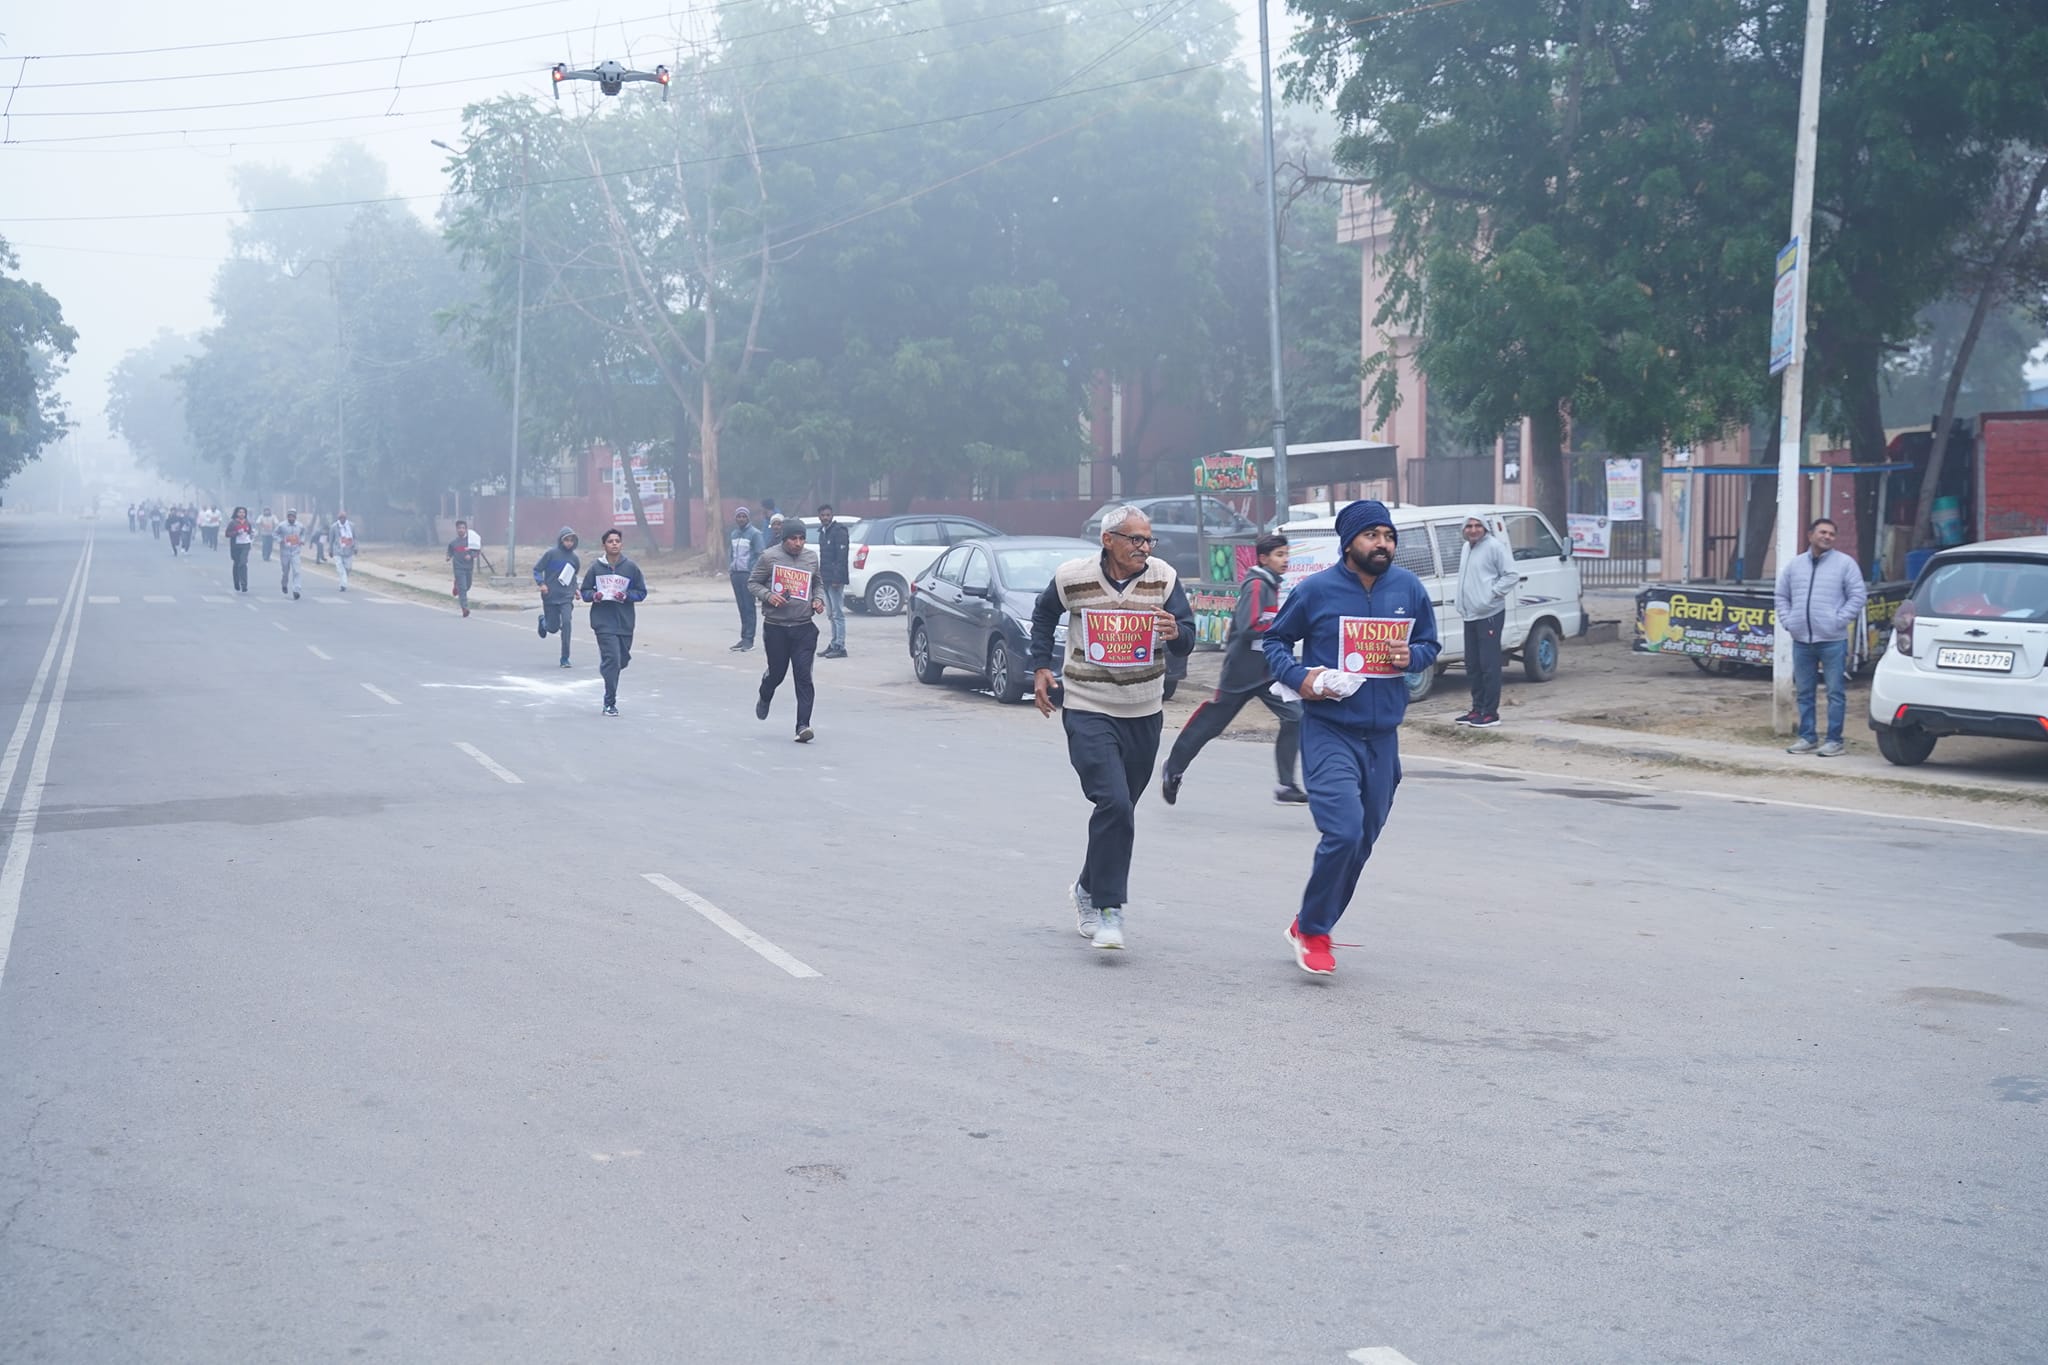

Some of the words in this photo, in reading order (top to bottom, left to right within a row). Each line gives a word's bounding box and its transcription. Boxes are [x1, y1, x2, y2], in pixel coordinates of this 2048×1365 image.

[599, 576, 627, 586] WISDOM
[774, 567, 809, 583] WISDOM
[1670, 594, 1724, 622] तिवारी
[1728, 606, 1766, 631] जूस
[1087, 614, 1153, 632] WISDOM
[1097, 632, 1143, 642] MARATHON
[1106, 643, 1132, 654] 2022
[1355, 641, 1390, 652] MARAT
[1944, 652, 2011, 667] HR20AC3778
